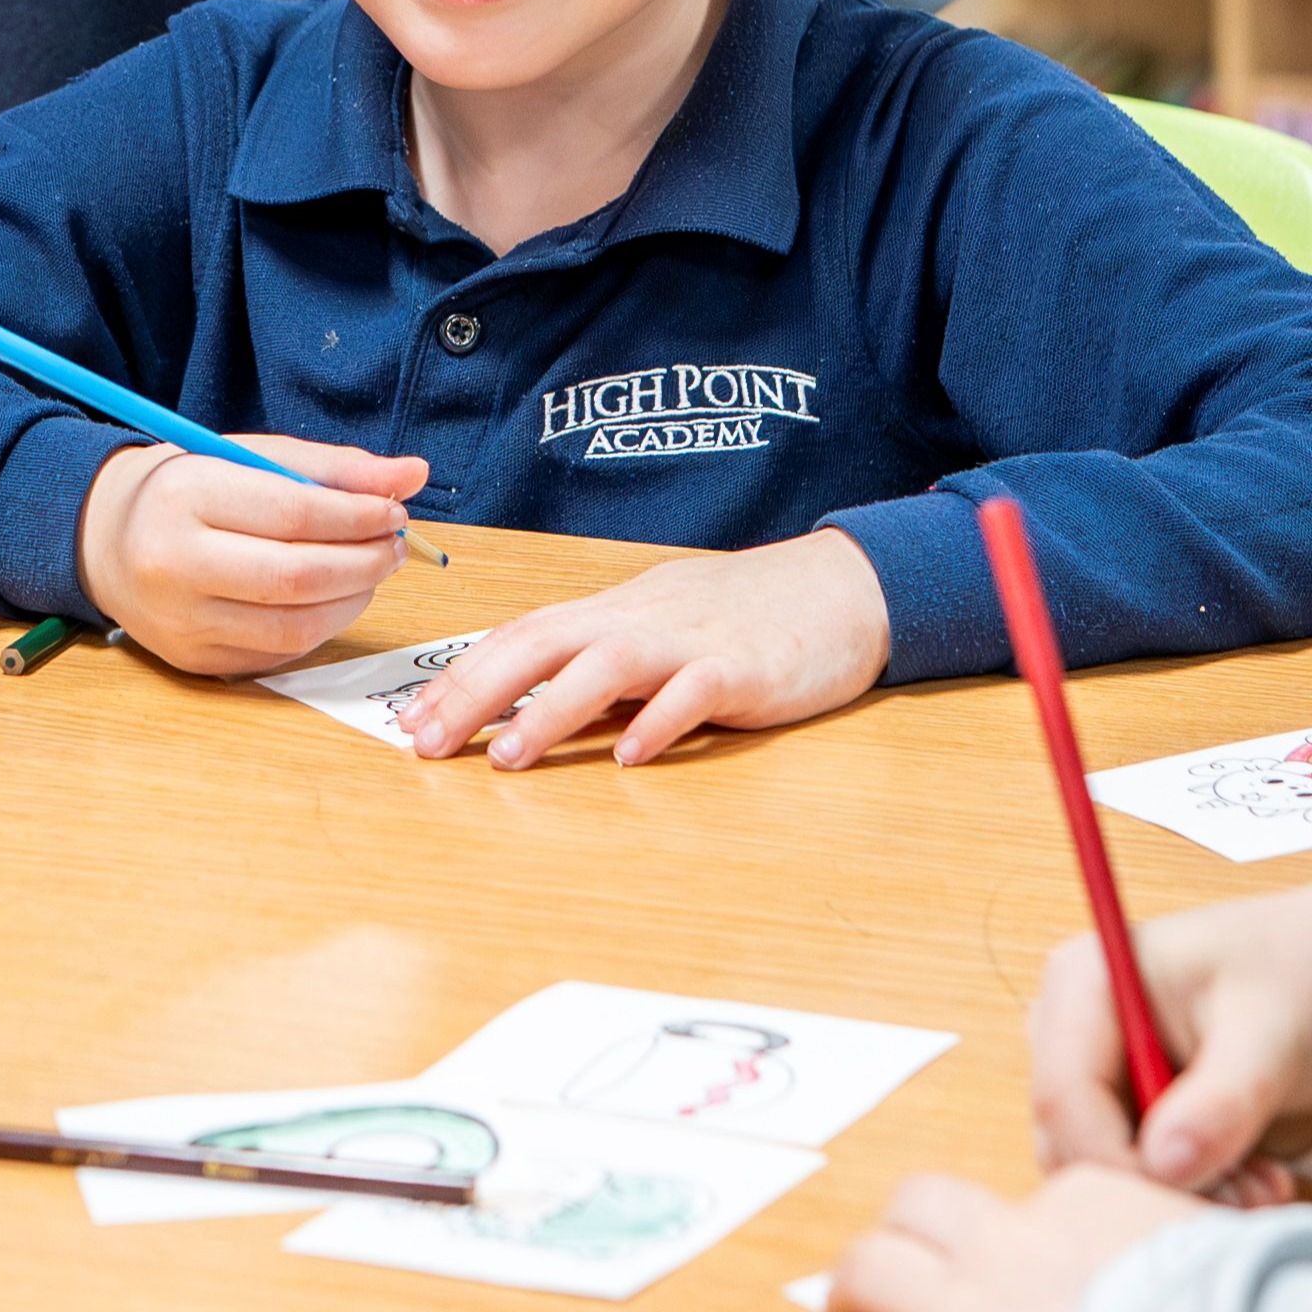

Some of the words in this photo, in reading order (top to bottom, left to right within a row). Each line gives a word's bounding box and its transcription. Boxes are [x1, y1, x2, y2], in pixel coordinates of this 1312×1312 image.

[543, 375, 666, 436] HIGH
[672, 364, 817, 416] POINT
[586, 419, 763, 453] ACADEMY
